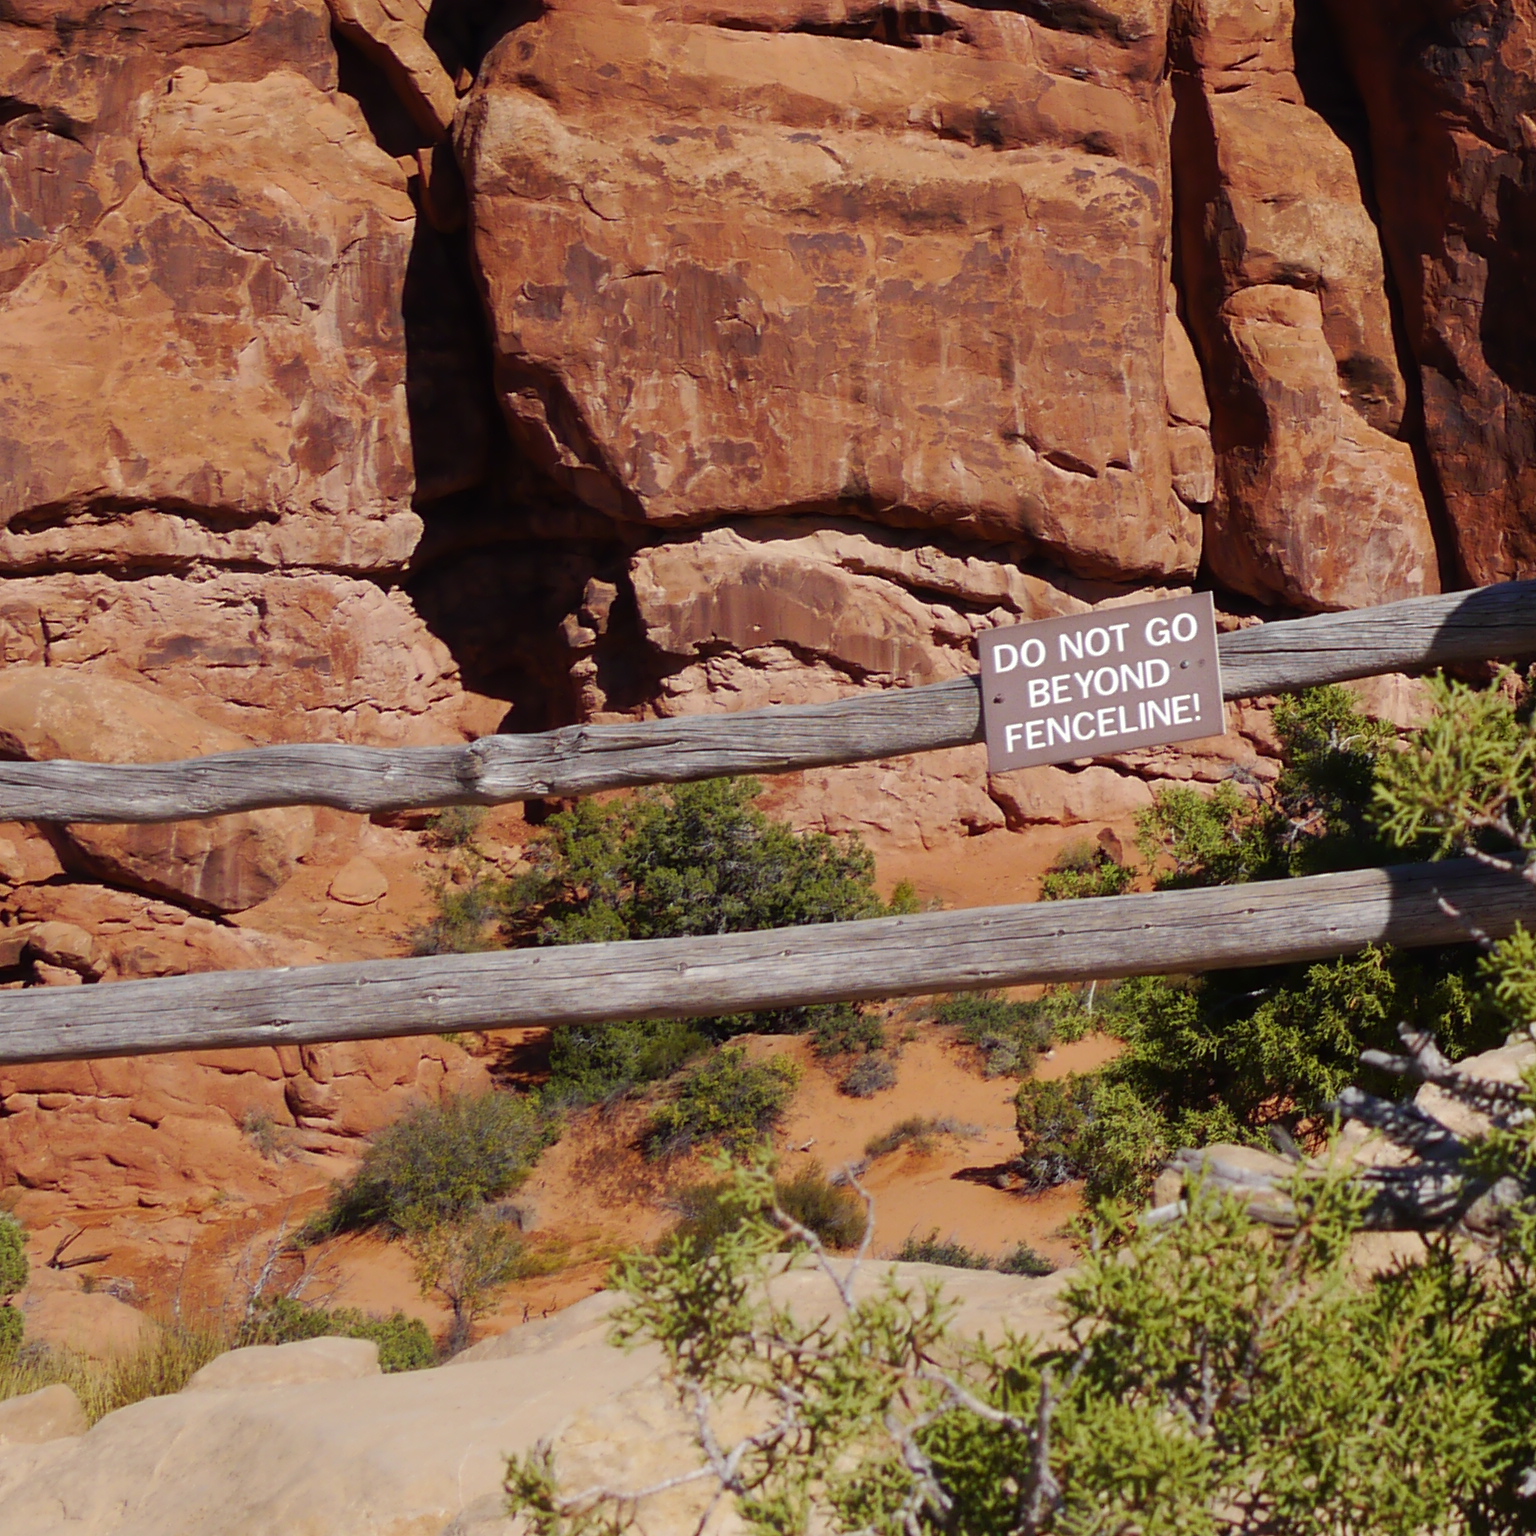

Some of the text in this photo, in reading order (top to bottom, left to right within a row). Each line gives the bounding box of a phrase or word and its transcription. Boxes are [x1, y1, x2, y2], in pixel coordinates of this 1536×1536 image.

[993, 612, 1198, 673] DO NOT GO
[1027, 658, 1170, 708] BEYOND
[1005, 693, 1201, 753] FENCELINE!
